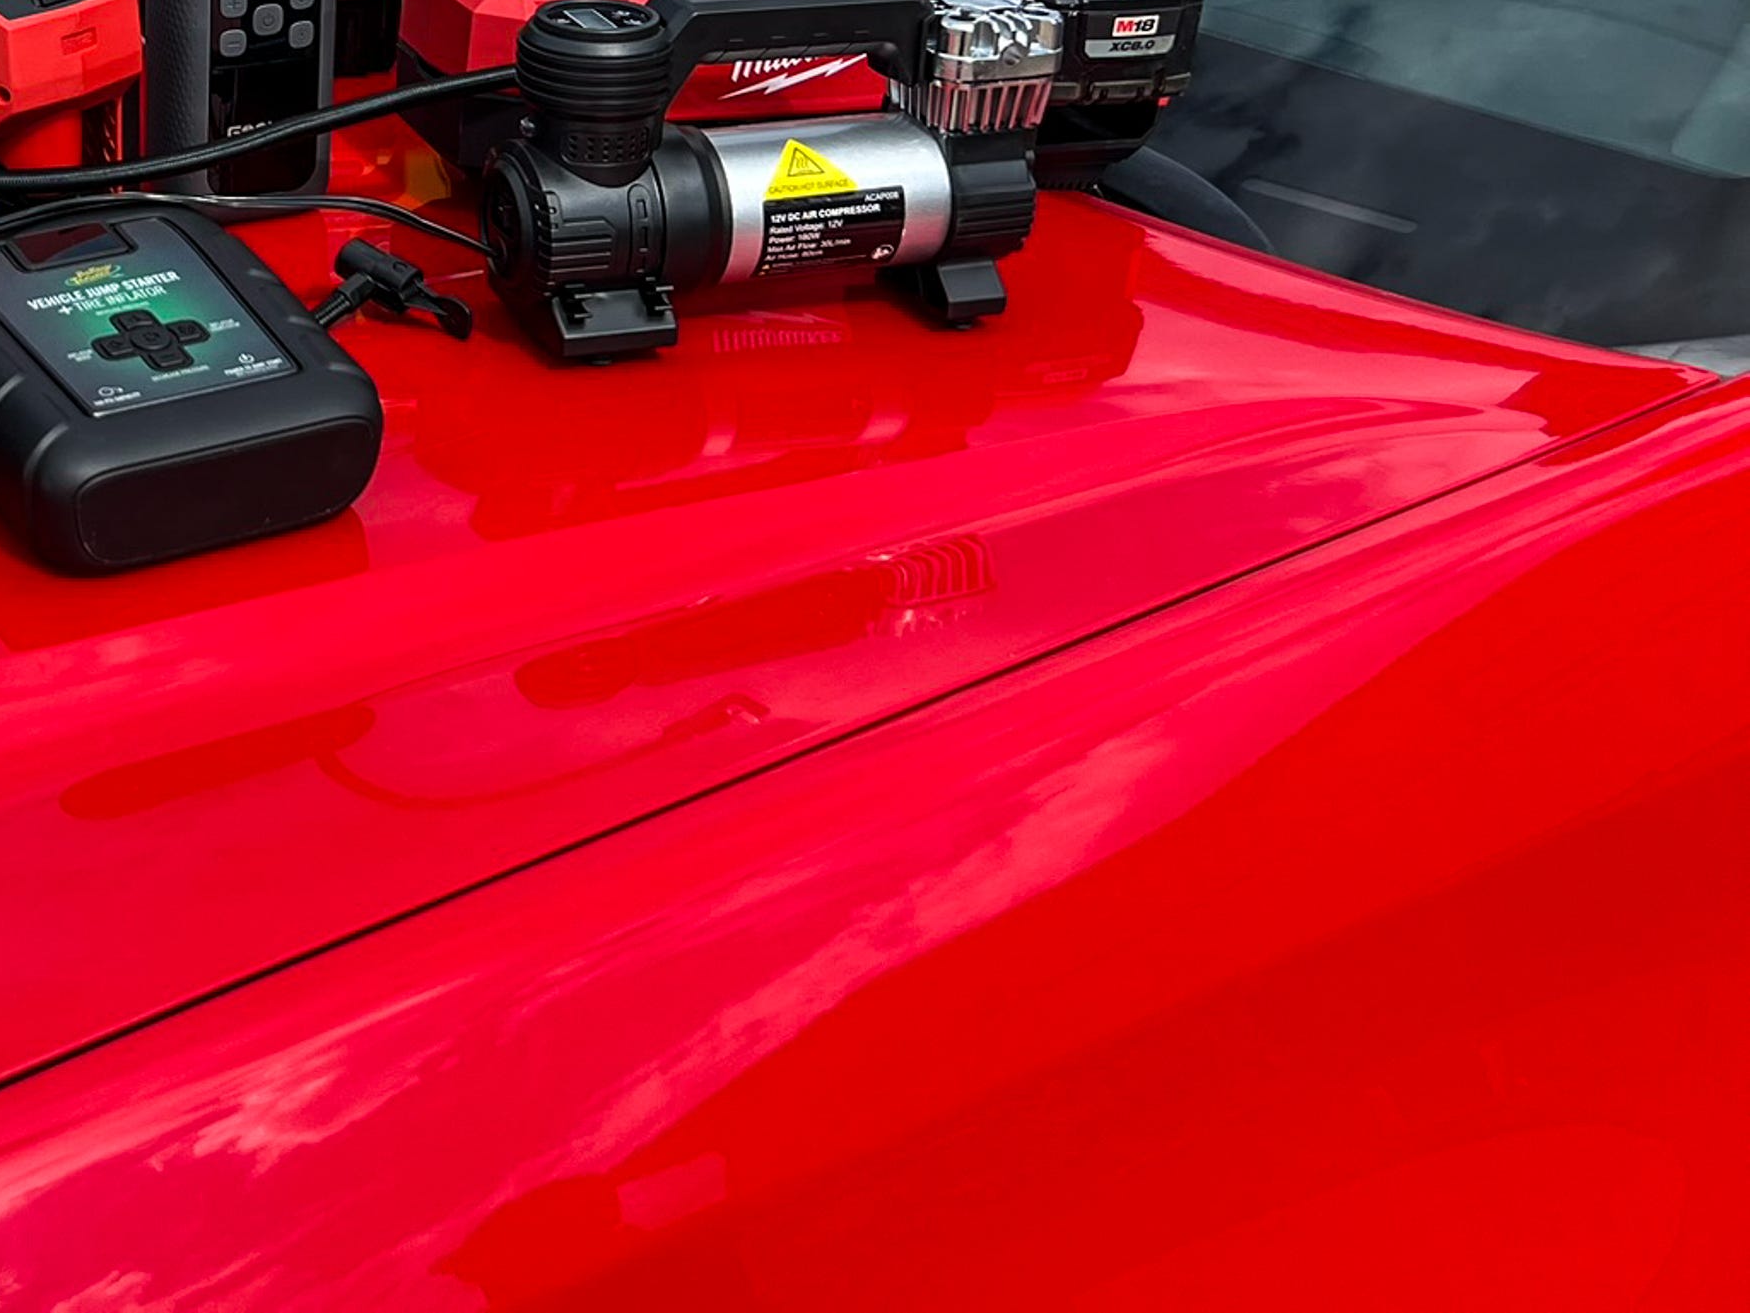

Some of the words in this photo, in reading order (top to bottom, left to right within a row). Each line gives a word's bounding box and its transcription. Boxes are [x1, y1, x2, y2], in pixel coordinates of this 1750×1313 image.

[1116, 19, 1155, 33] M18
[770, 214, 787, 224] 12V
[787, 212, 801, 222] DC
[801, 210, 818, 220] AIR
[818, 203, 881, 219] COMPRESSOR
[827, 219, 843, 228] 12V
[27, 290, 86, 311] VEHICLE
[86, 282, 120, 297] JUMP
[121, 270, 181, 290] STARTER
[72, 297, 106, 312] TIRE
[105, 285, 167, 307] INFLATOR
